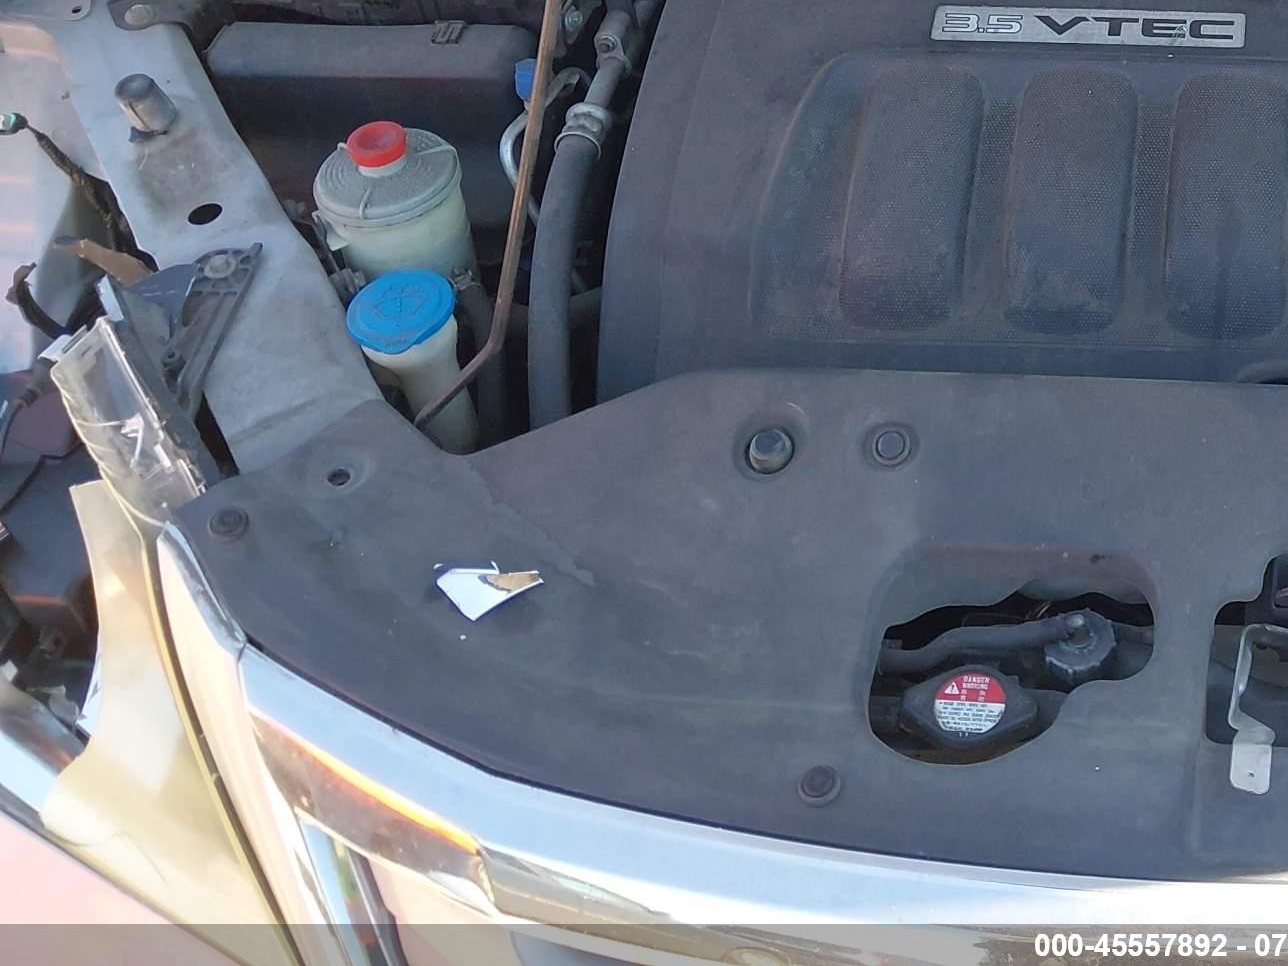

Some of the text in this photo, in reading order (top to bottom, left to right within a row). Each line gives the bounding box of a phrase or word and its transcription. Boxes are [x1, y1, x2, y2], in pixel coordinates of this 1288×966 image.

[942, 12, 1236, 40] 3.5 VTEC
[963, 675, 990, 683] DANGER
